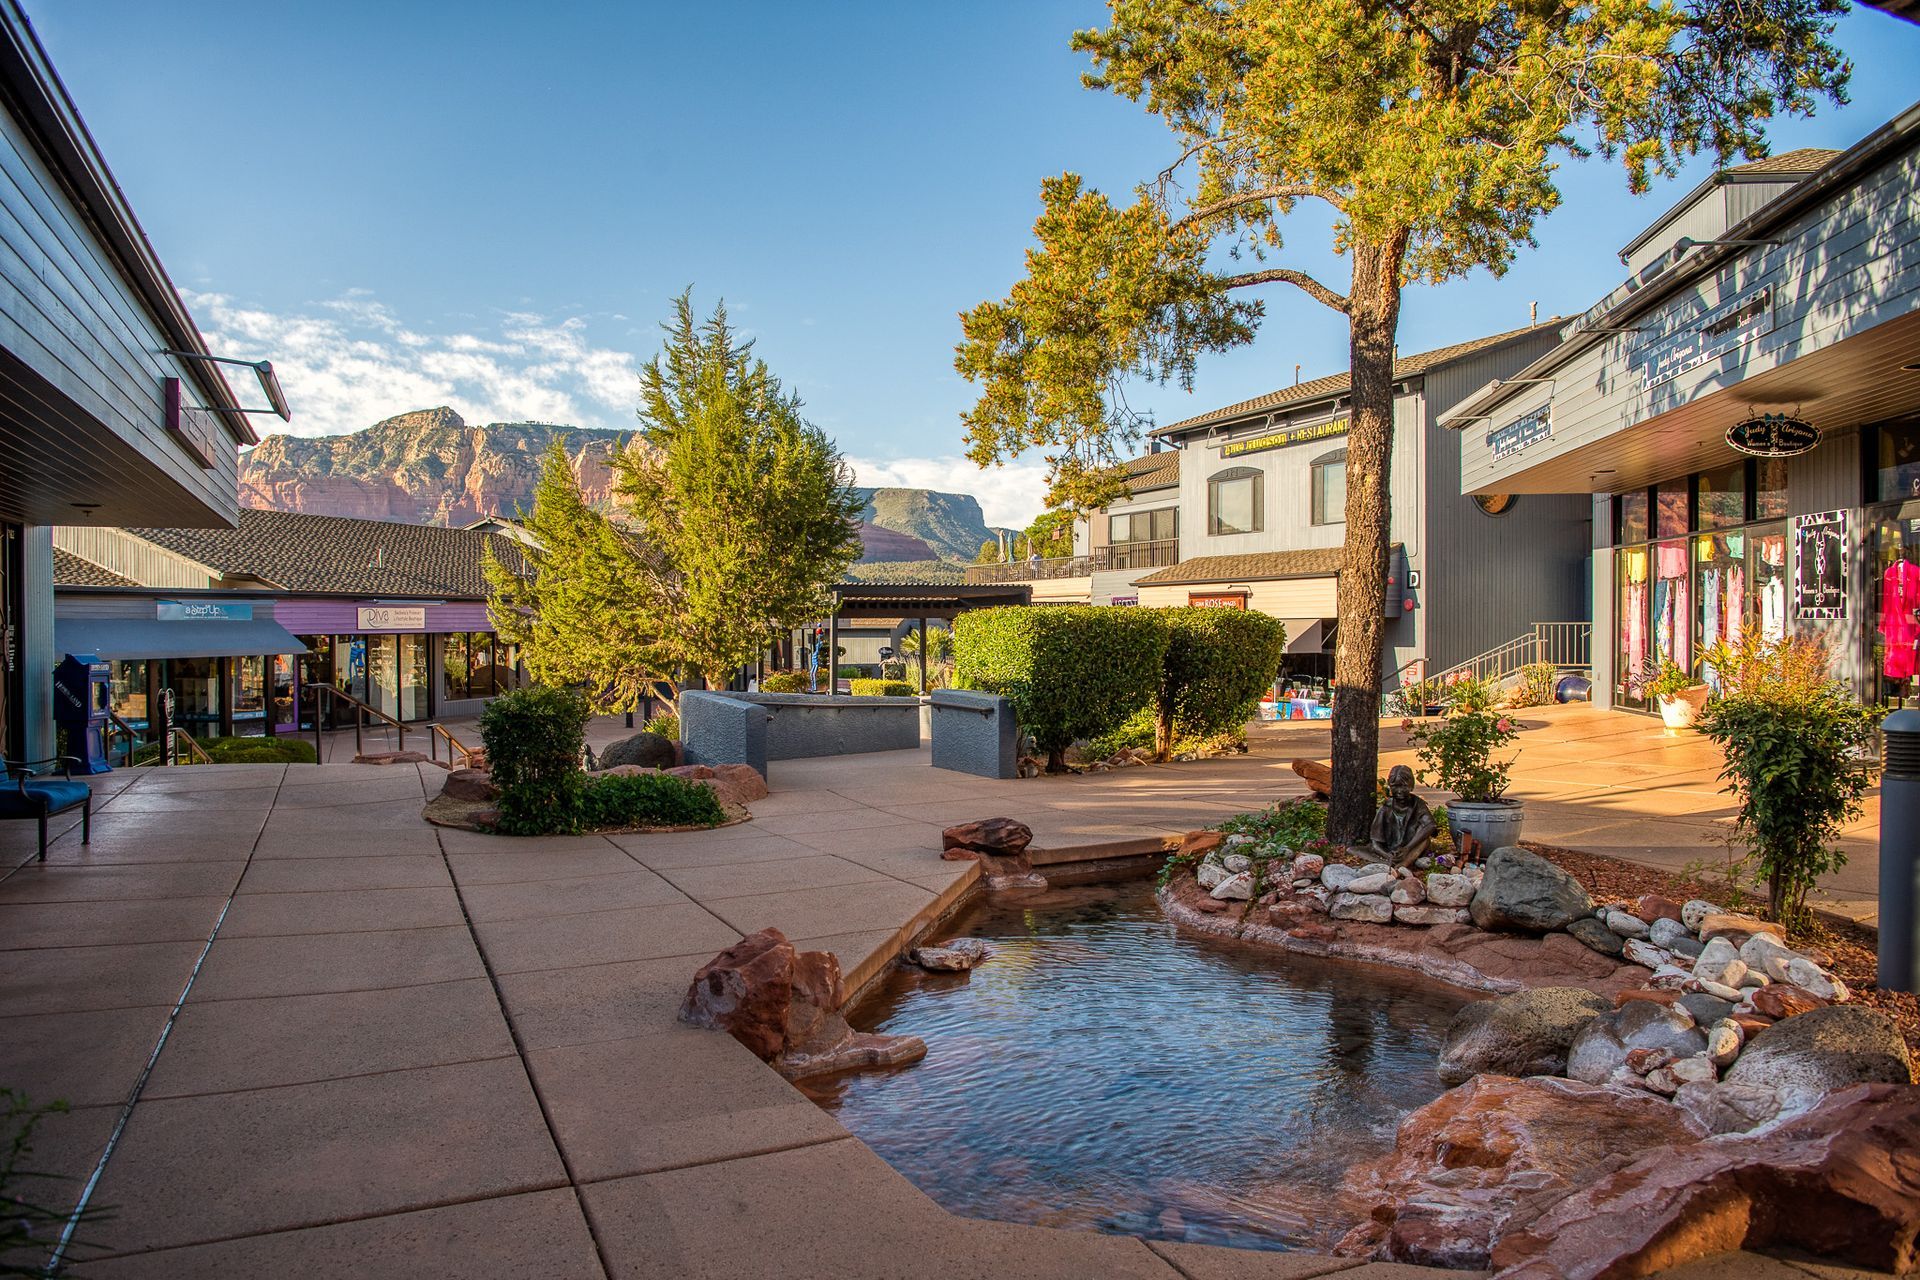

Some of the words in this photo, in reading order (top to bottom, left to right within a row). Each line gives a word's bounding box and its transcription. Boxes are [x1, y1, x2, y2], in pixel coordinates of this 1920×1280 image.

[1296, 418, 1349, 441] RESTAURANT
[1744, 425, 1766, 438] Judy
[1781, 424, 1814, 439] Arizona
[1747, 438, 1771, 447] Women's
[1778, 438, 1803, 448] Boutique
[1409, 571, 1419, 587] D
[1205, 600, 1222, 608] ROSE
